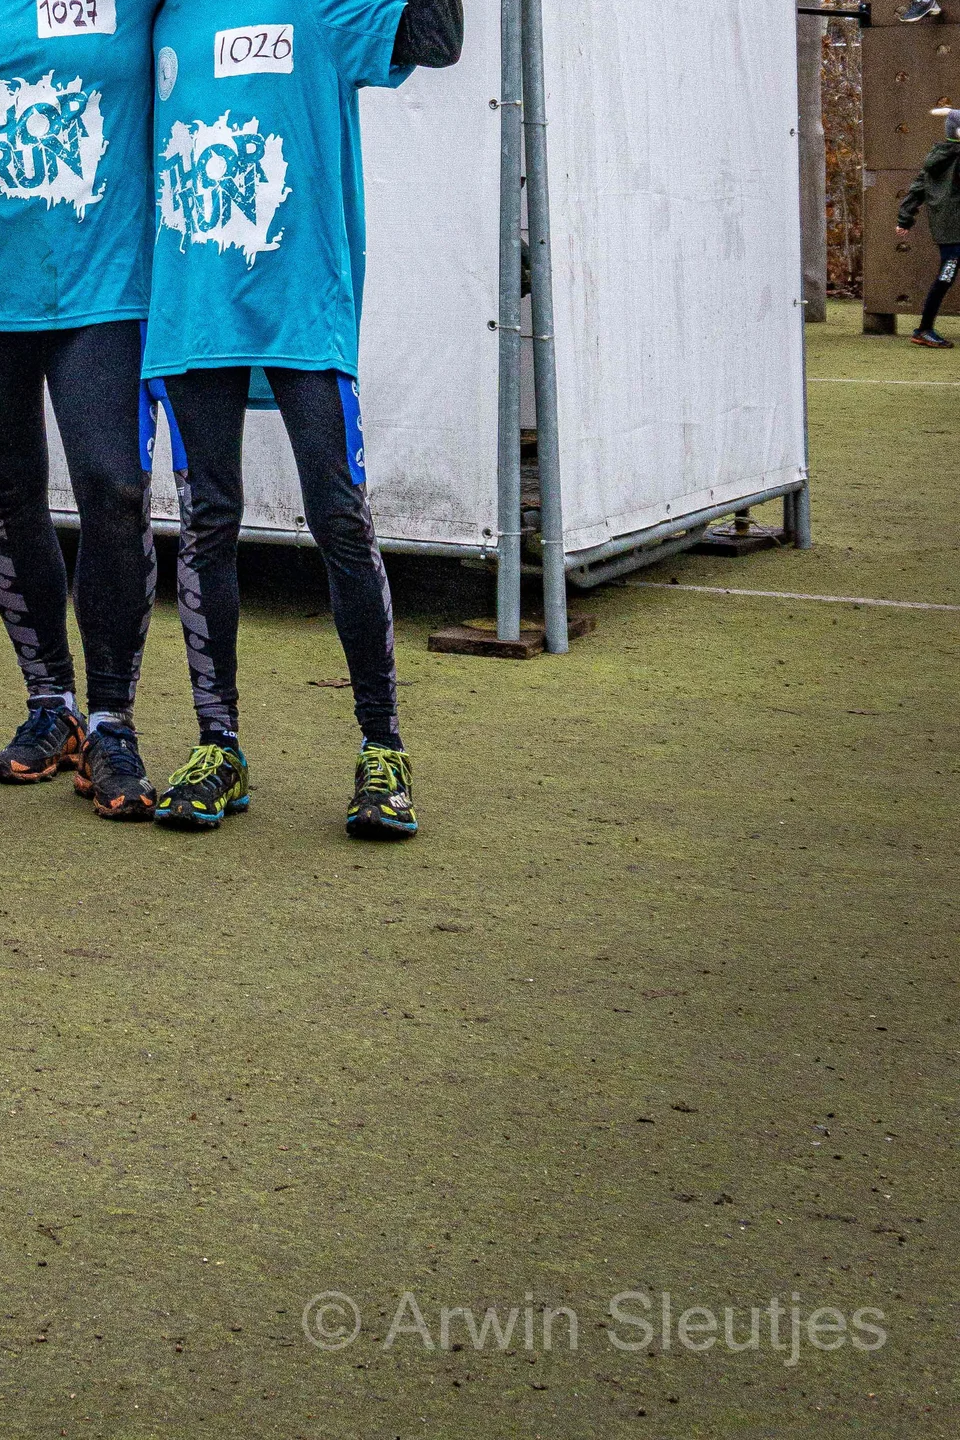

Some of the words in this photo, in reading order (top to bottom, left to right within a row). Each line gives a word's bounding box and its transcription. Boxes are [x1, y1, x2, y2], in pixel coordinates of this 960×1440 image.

[219, 25, 292, 63] 1026
[157, 134, 270, 213] THOR
[178, 174, 258, 236] RUN
